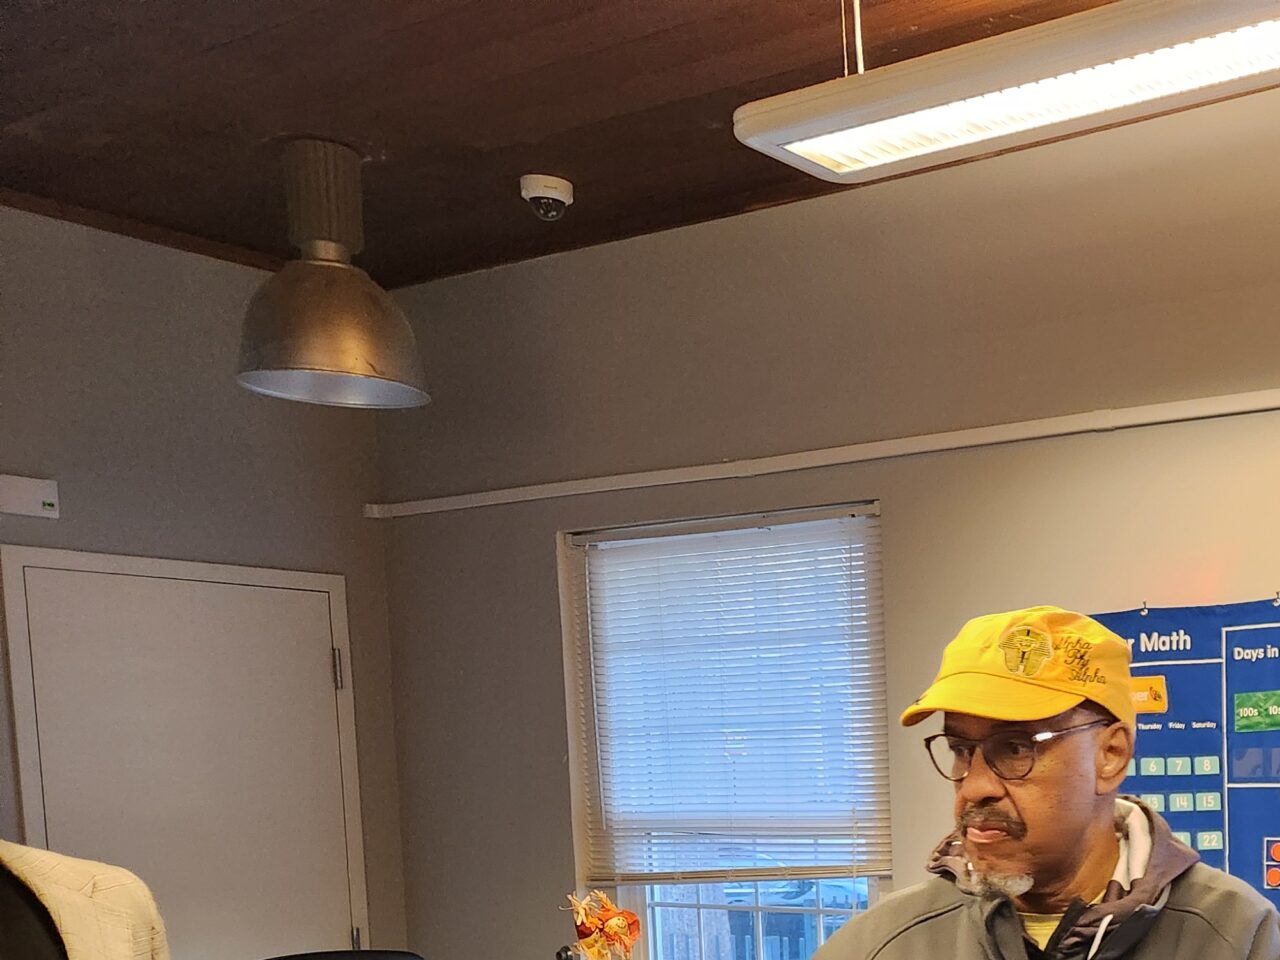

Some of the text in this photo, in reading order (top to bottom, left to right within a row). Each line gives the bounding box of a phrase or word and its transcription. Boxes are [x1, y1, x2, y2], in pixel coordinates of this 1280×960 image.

[1140, 629, 1192, 652] Math
[1233, 647, 1265, 662] Days
[1266, 644, 1279, 658] in
[1239, 708, 1259, 718] 100s
[1168, 722, 1186, 730] Friday
[1149, 760, 1157, 773] 6
[1175, 760, 1183, 773] 7
[1203, 758, 1212, 772] 8
[1176, 796, 1188, 809] 14
[1202, 795, 1215, 808] 15
[1202, 834, 1219, 847] 22
